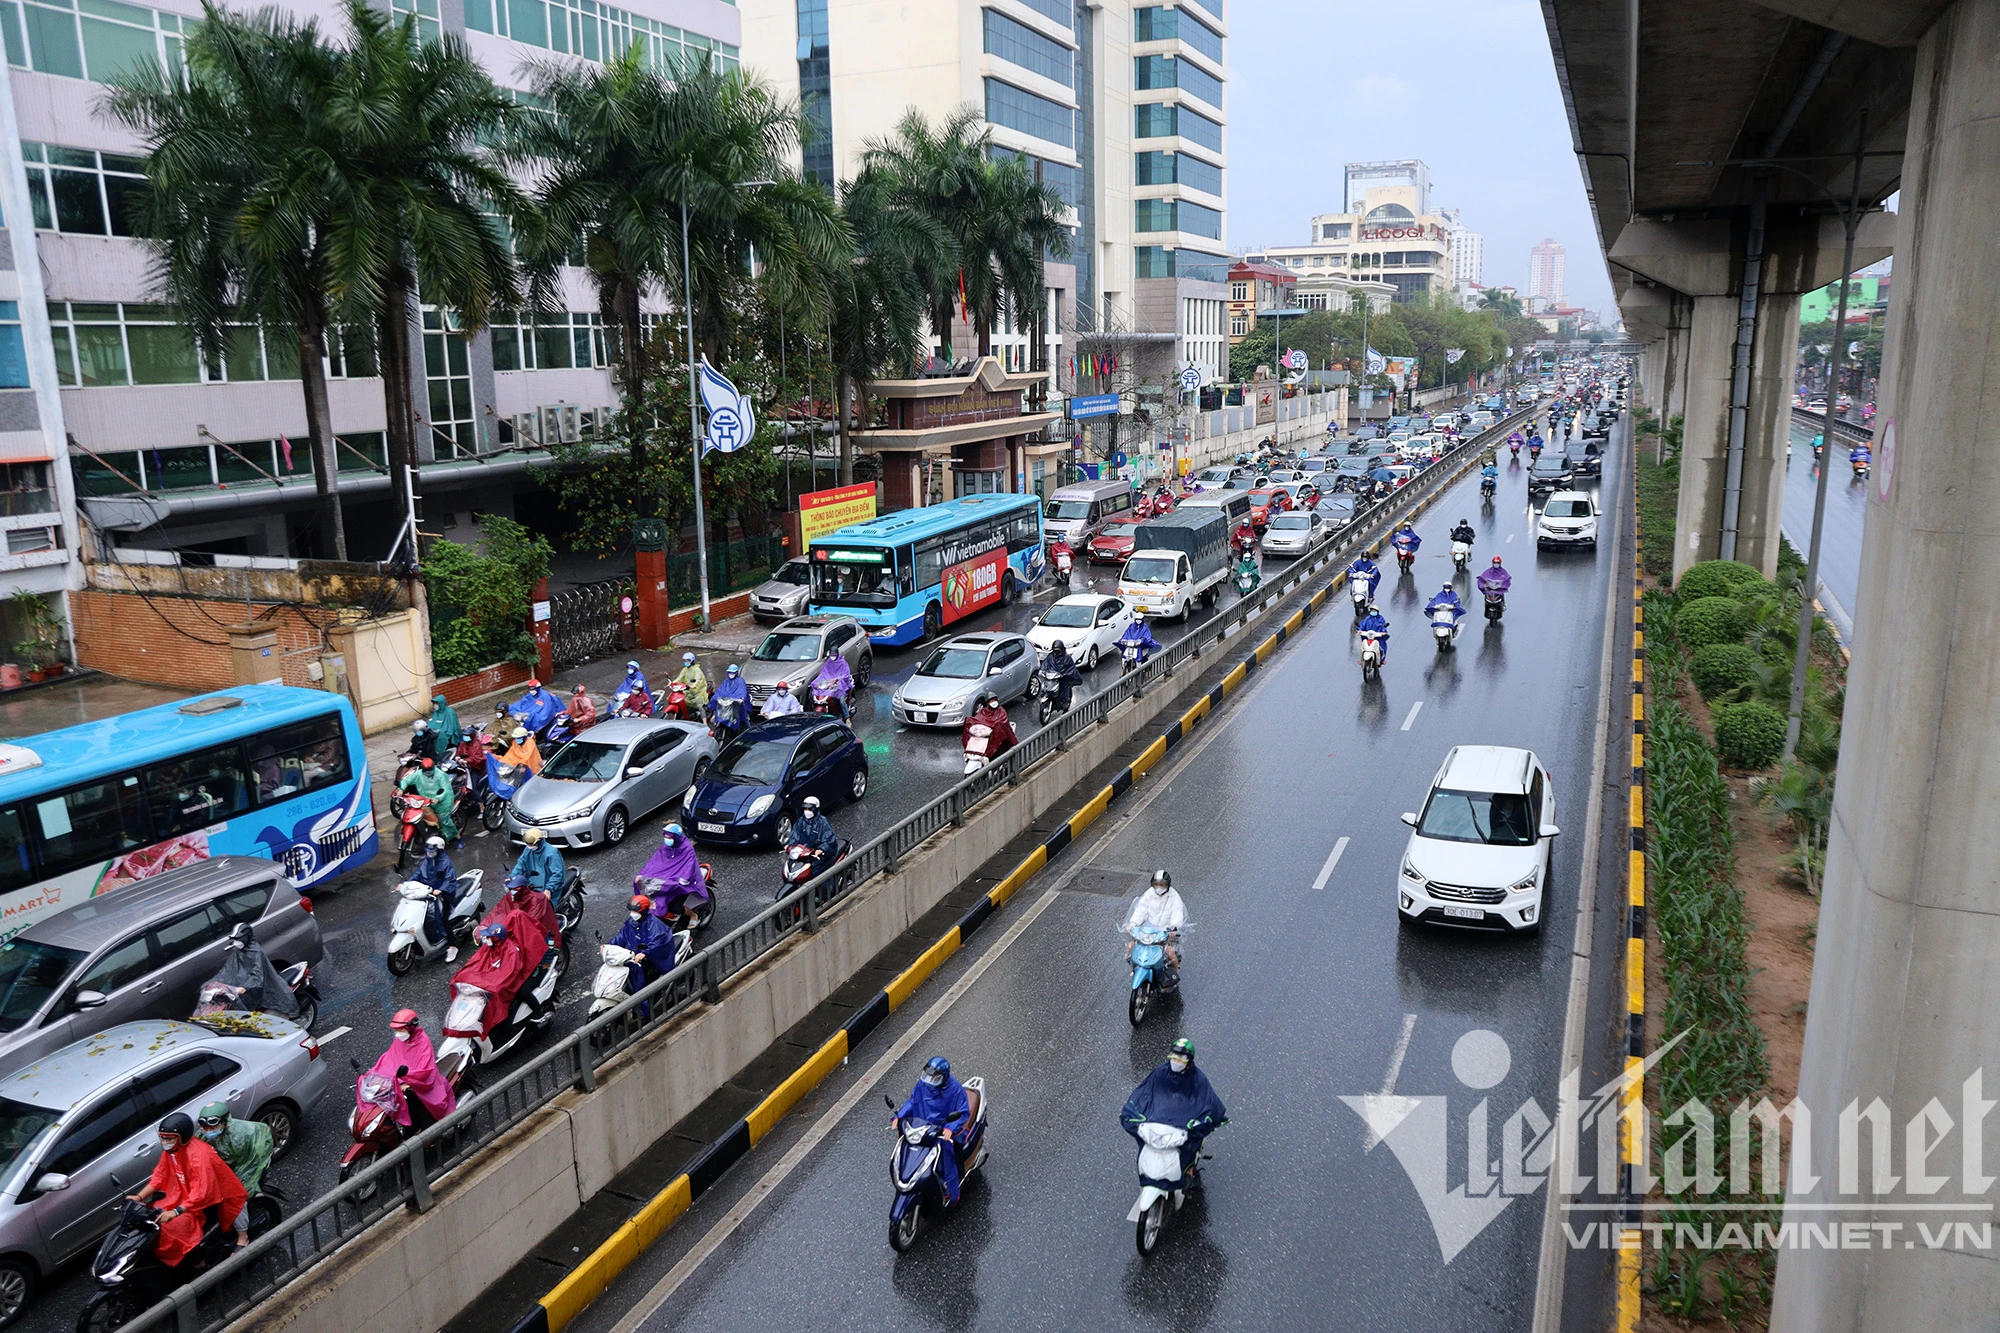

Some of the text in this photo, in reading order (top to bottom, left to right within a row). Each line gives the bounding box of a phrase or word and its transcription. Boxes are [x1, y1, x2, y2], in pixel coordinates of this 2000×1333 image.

[1364, 227, 1425, 240] LICOGI
[957, 531, 1005, 561] vietnamobile
[972, 562, 997, 591] 180GB
